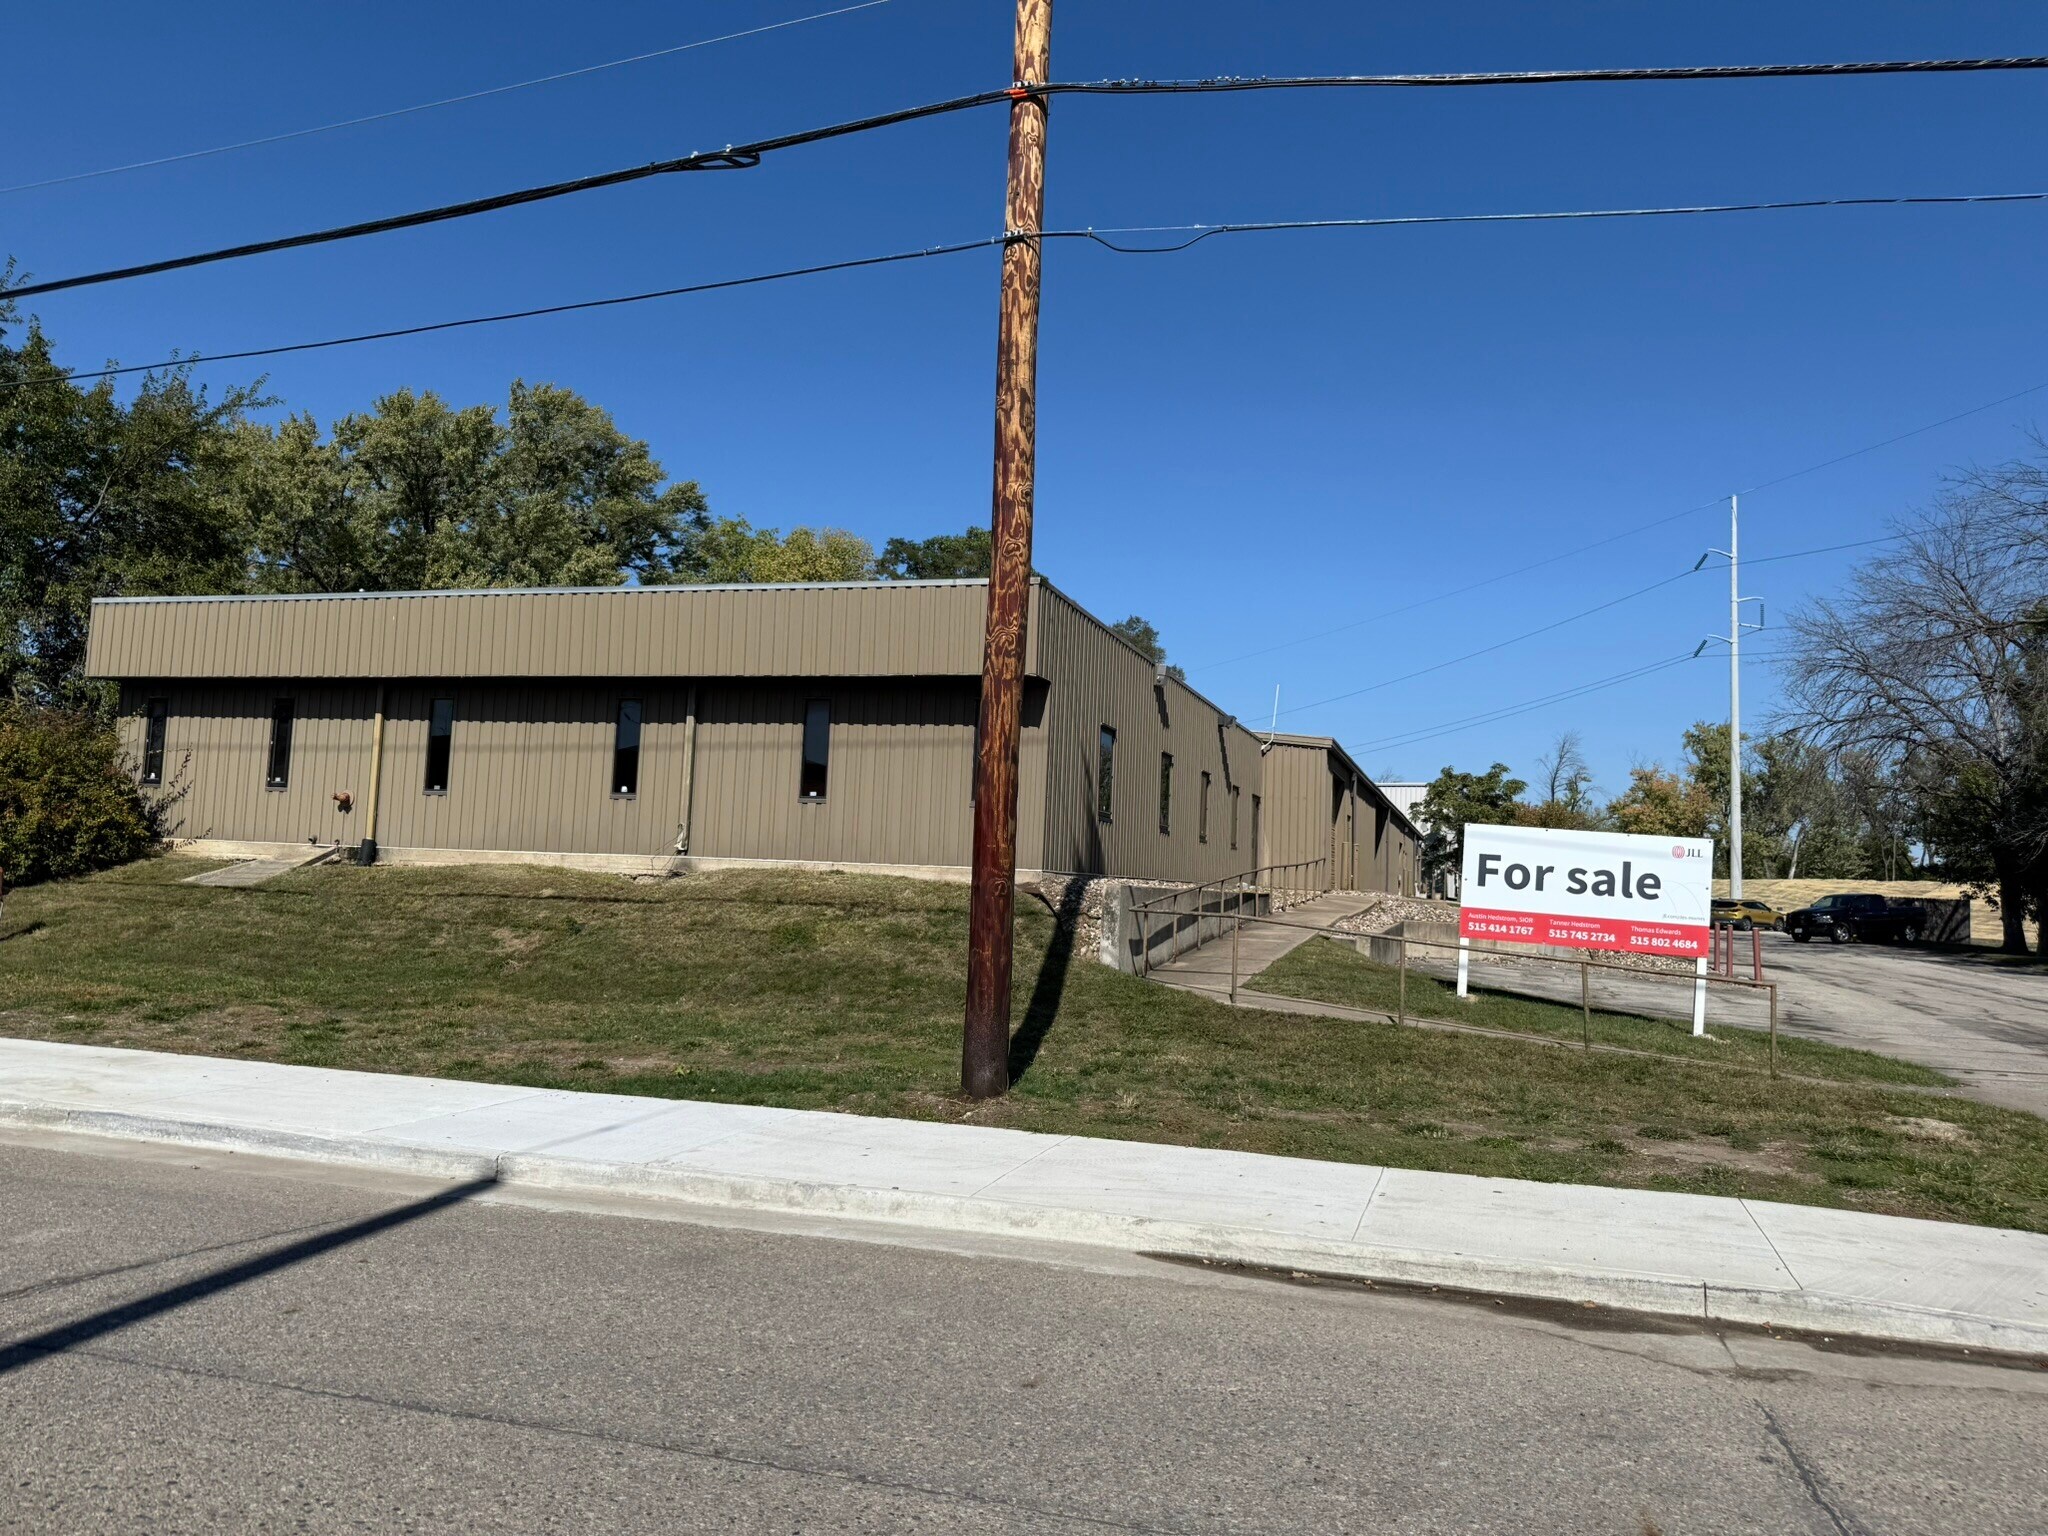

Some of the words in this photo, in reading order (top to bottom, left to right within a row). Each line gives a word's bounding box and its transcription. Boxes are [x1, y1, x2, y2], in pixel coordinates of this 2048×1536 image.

[1686, 848, 1703, 858] JLL
[1477, 853, 1555, 892] For
[1566, 861, 1661, 900] sale
[1467, 912, 1486, 920] Austin
[1519, 916, 1534, 924] SIOR
[1549, 919, 1570, 927] Tanner
[1571, 921, 1601, 929] Hedstrom
[1468, 921, 1486, 931] 515
[1487, 923, 1507, 933] 414
[1509, 925, 1534, 935] 1767
[1630, 925, 1655, 934] Thomas
[1548, 928, 1568, 938] 515
[1569, 930, 1588, 940] 745
[1590, 932, 1616, 942] 2734
[1630, 935, 1649, 945] 515
[1651, 937, 1670, 947] 802
[1672, 939, 1698, 949] 4684
